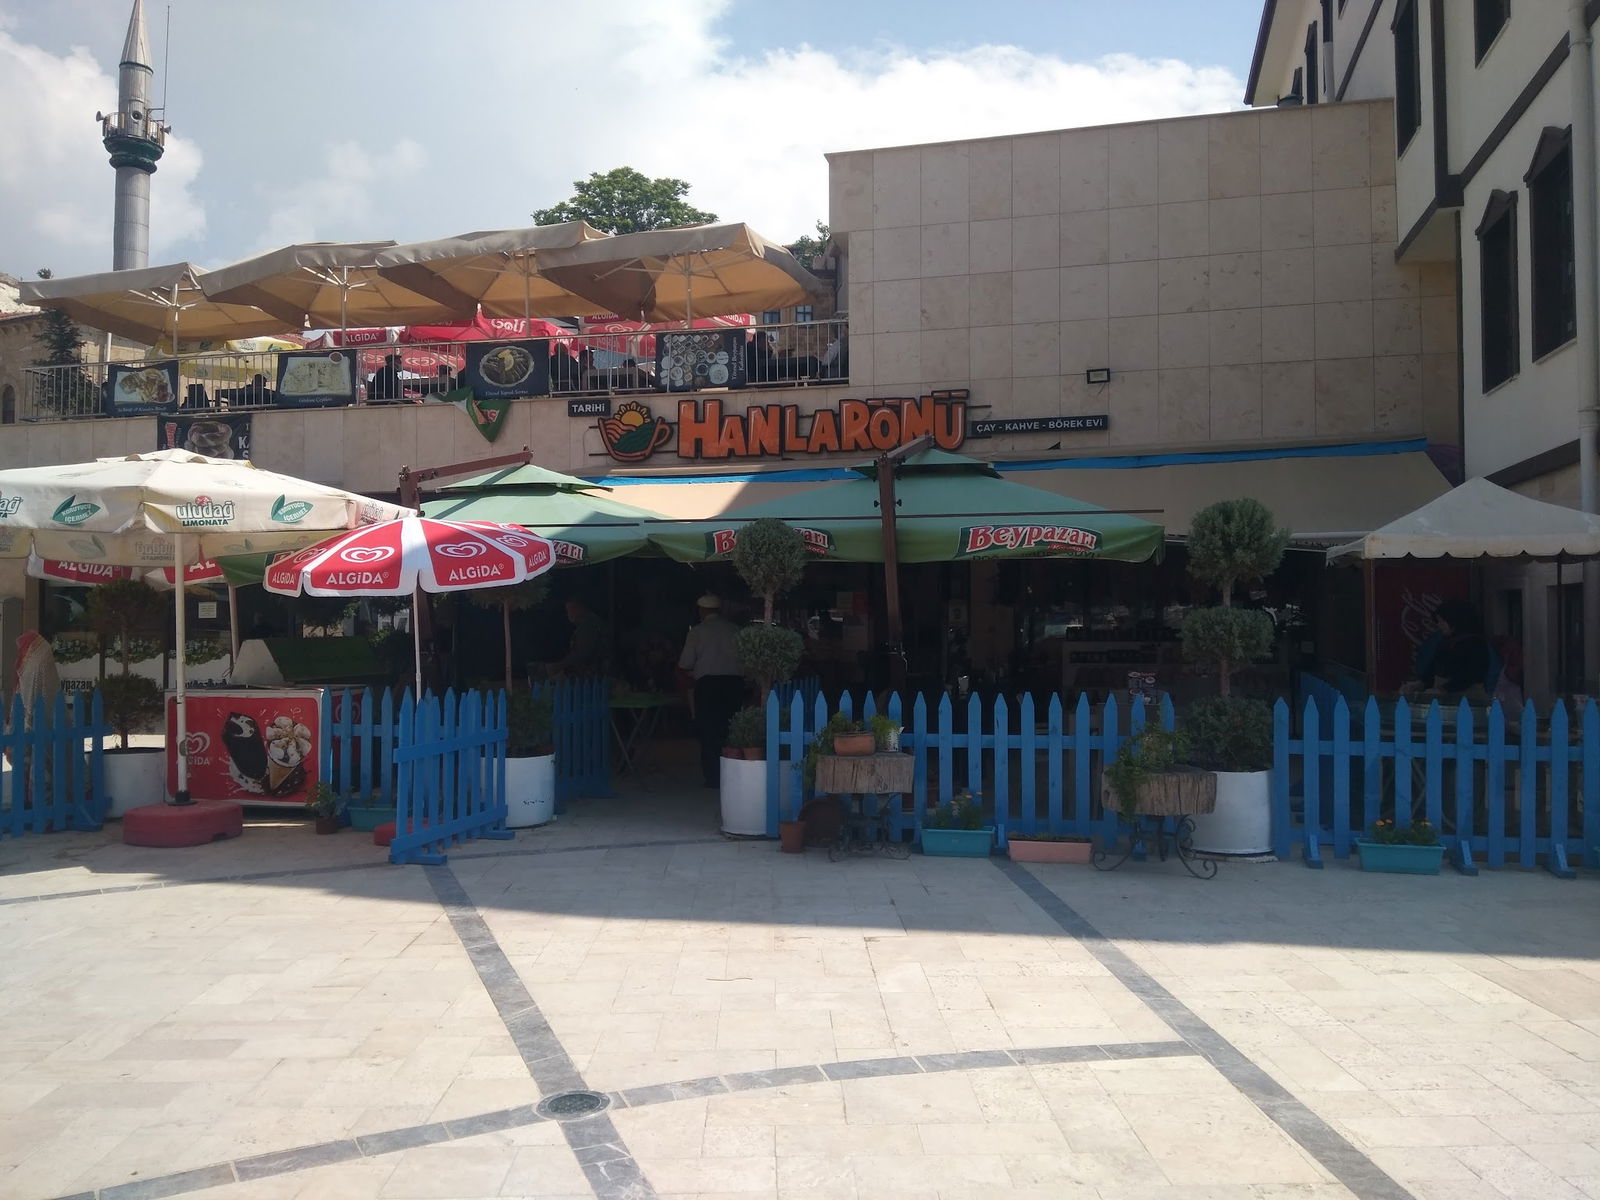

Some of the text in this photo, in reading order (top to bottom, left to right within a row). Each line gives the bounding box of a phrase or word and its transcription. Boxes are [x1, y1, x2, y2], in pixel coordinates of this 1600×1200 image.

[976, 424, 996, 433] ÇAY
[1005, 421, 1040, 431] KAHVE
[1048, 419, 1084, 429] BÖREK
